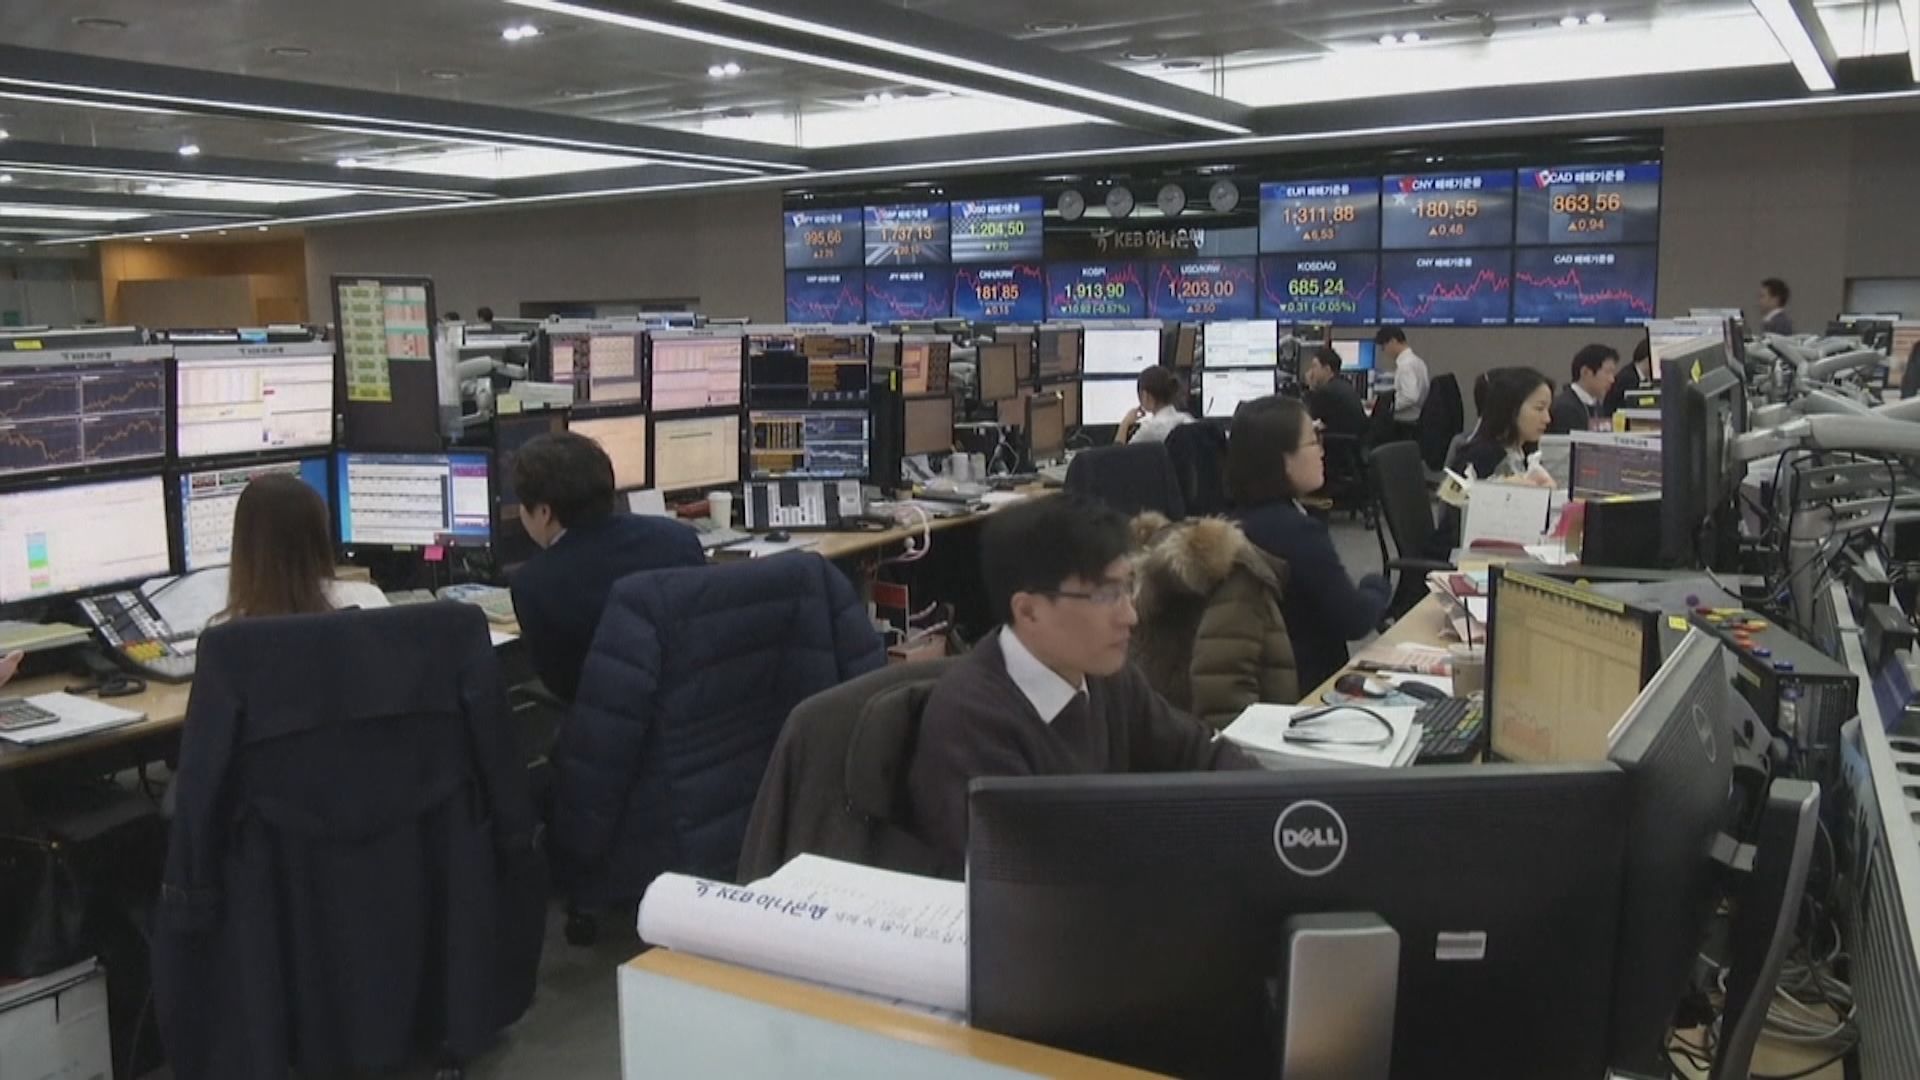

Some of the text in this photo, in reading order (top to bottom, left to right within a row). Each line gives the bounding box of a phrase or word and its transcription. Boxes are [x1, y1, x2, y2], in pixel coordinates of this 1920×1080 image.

[1412, 179, 1433, 190] CNY
[1550, 173, 1572, 184] CAD
[1416, 200, 1478, 219] 180.55
[1552, 194, 1621, 213] 863.56
[1284, 204, 1354, 225] 1,311.88
[969, 221, 1025, 238] 1,204.50
[1114, 231, 1144, 248] KEB
[1297, 261, 1337, 271] KOSDAQ
[975, 284, 1019, 302] 181.85
[1064, 282, 1125, 300] 1,913.90
[1168, 280, 1235, 300] 1,203.00
[1288, 278, 1345, 297] 685.24
[1282, 827, 1340, 848] DELL
